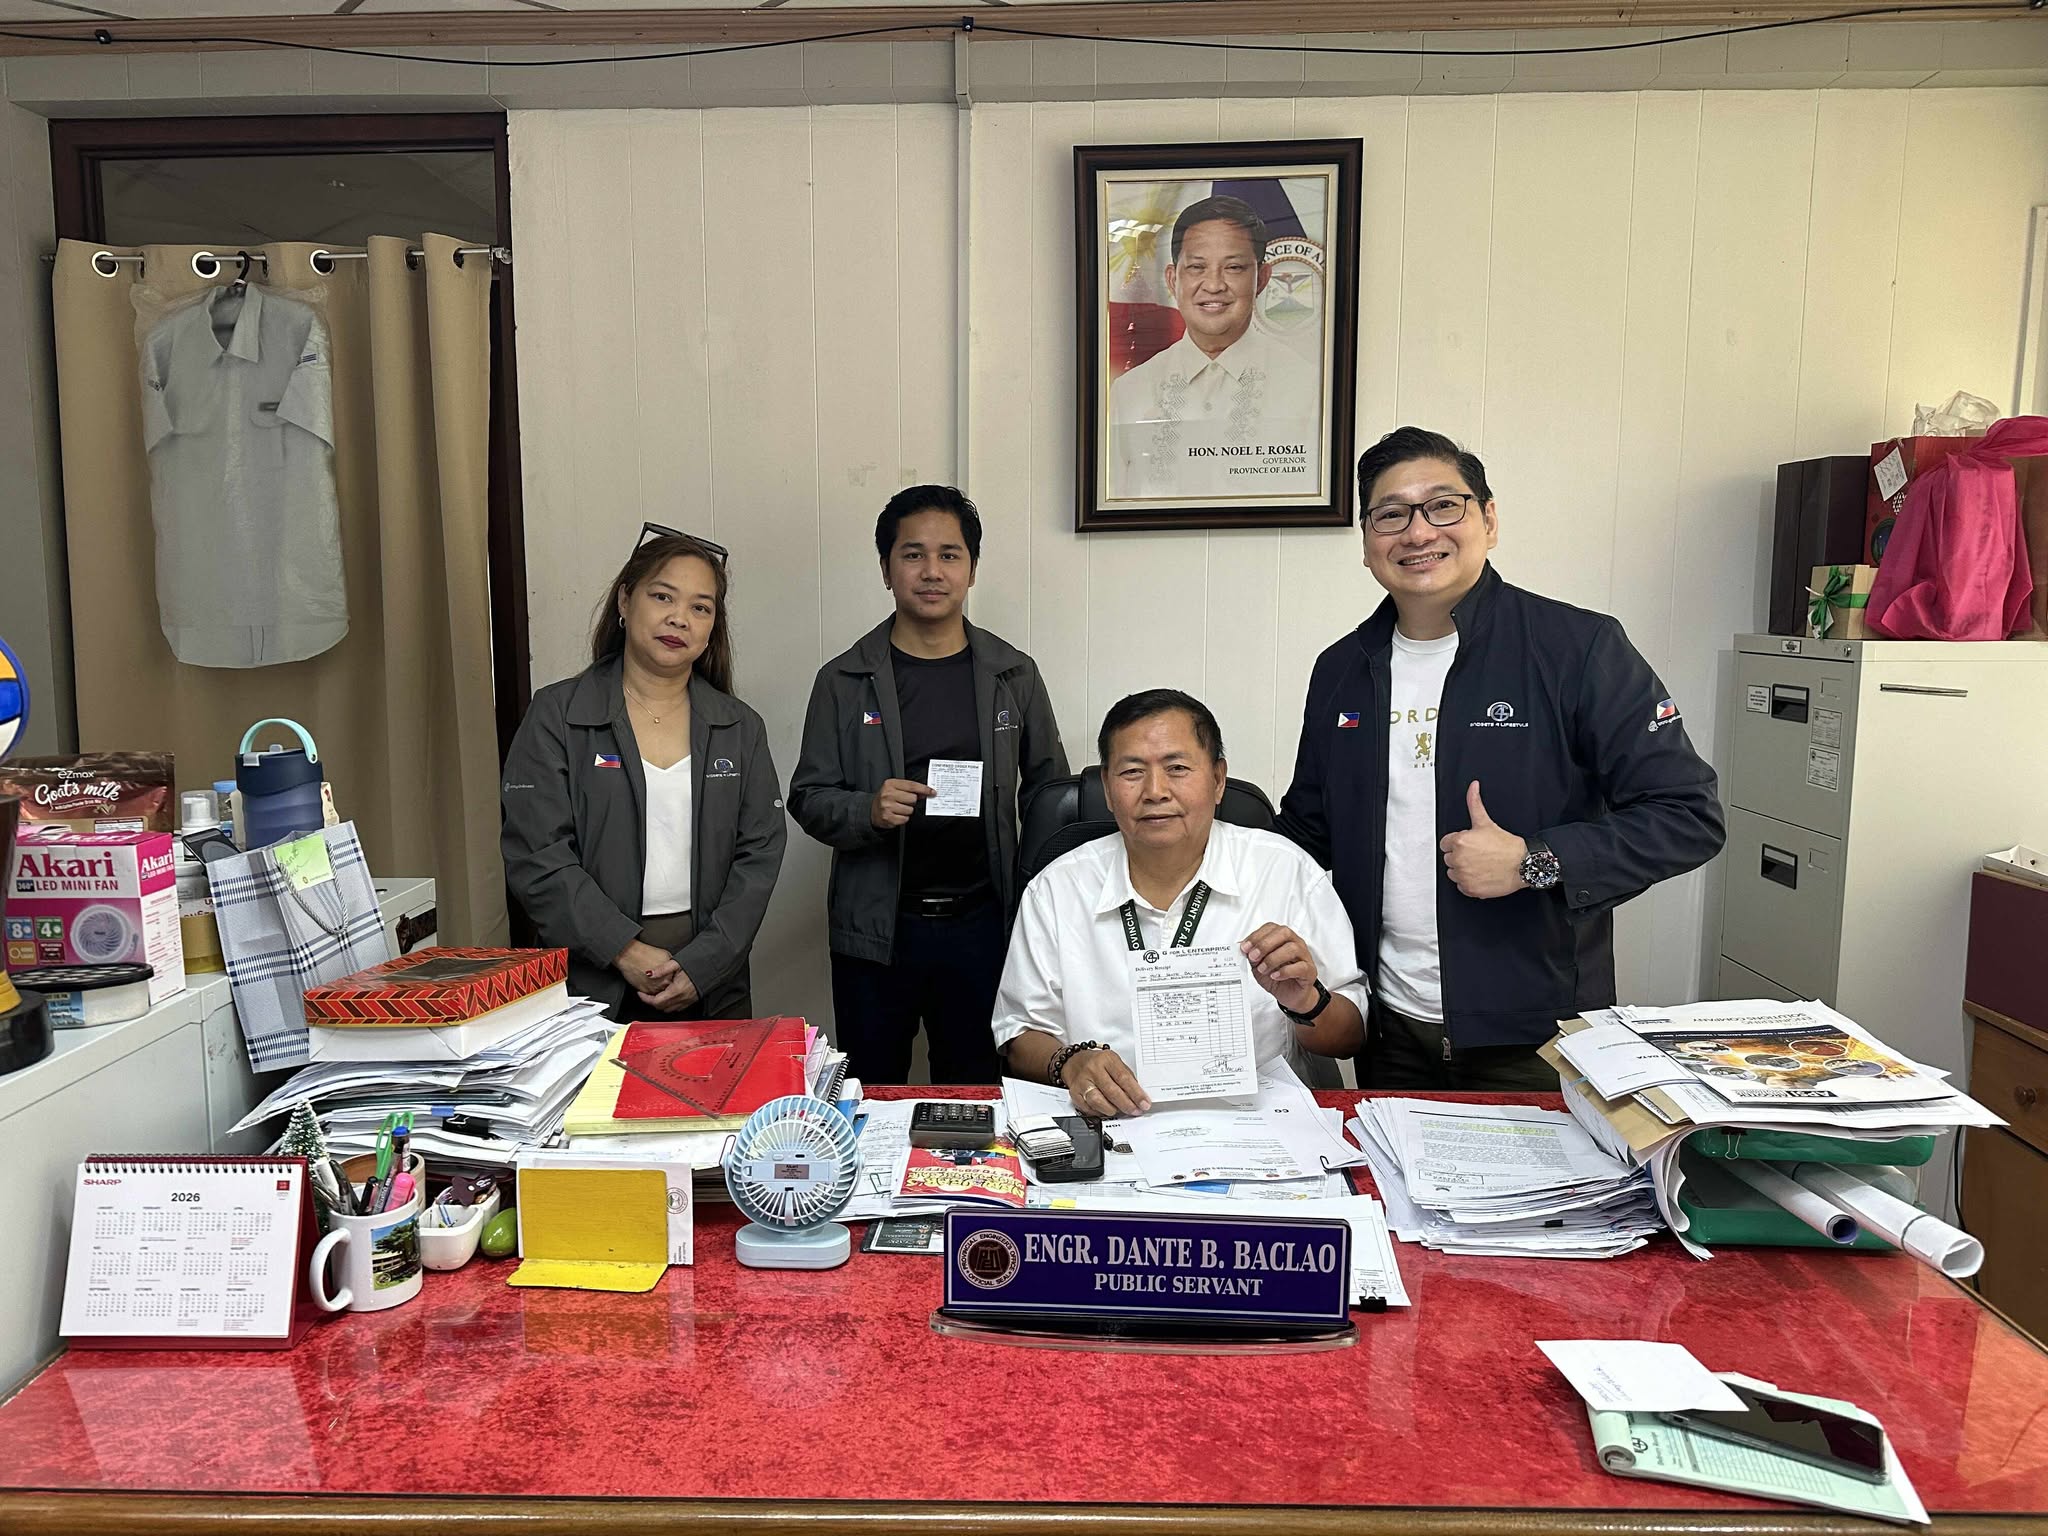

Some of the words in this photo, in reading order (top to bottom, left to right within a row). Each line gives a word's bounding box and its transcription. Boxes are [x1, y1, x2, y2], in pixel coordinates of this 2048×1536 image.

[1294, 244, 1313, 255] OF
[1188, 447, 1219, 457] HON.
[1221, 446, 1253, 456] NOEL
[1255, 445, 1266, 456] E.
[1268, 444, 1307, 455] ROSAL
[1262, 456, 1307, 465] GOVERNOR
[1229, 466, 1269, 475] PROVINCE
[1269, 466, 1281, 474] OF
[1281, 465, 1307, 474] ALBAY
[35, 781, 79, 805] Goat's
[83, 781, 122, 801] milk
[17, 851, 116, 878] Akari
[141, 849, 174, 873] Akari
[36, 879, 58, 891] LED
[62, 879, 91, 891] MINI
[95, 879, 119, 891] FAN
[12, 922, 23, 938] 8
[40, 921, 53, 937] 4
[1183, 920, 1193, 934] OF
[1187, 946, 1231, 954] ENTERPRISE
[171, 1192, 201, 1202] 2026
[961, 1237, 978, 1270] PROVINCIAL
[979, 1233, 1013, 1250] ENGINEER'S
[1009, 1250, 1017, 1272] OFFICE
[1023, 1233, 1099, 1265] ENGR.
[1106, 1235, 1193, 1268] DANTE
[1200, 1239, 1225, 1270] B.
[1233, 1240, 1337, 1273] BACLAO
[968, 1273, 995, 1286] OFFICIAL
[995, 1273, 1011, 1285] SEAL
[1093, 1273, 1168, 1293] PUBLIC
[1172, 1275, 1263, 1296] SERVANT
